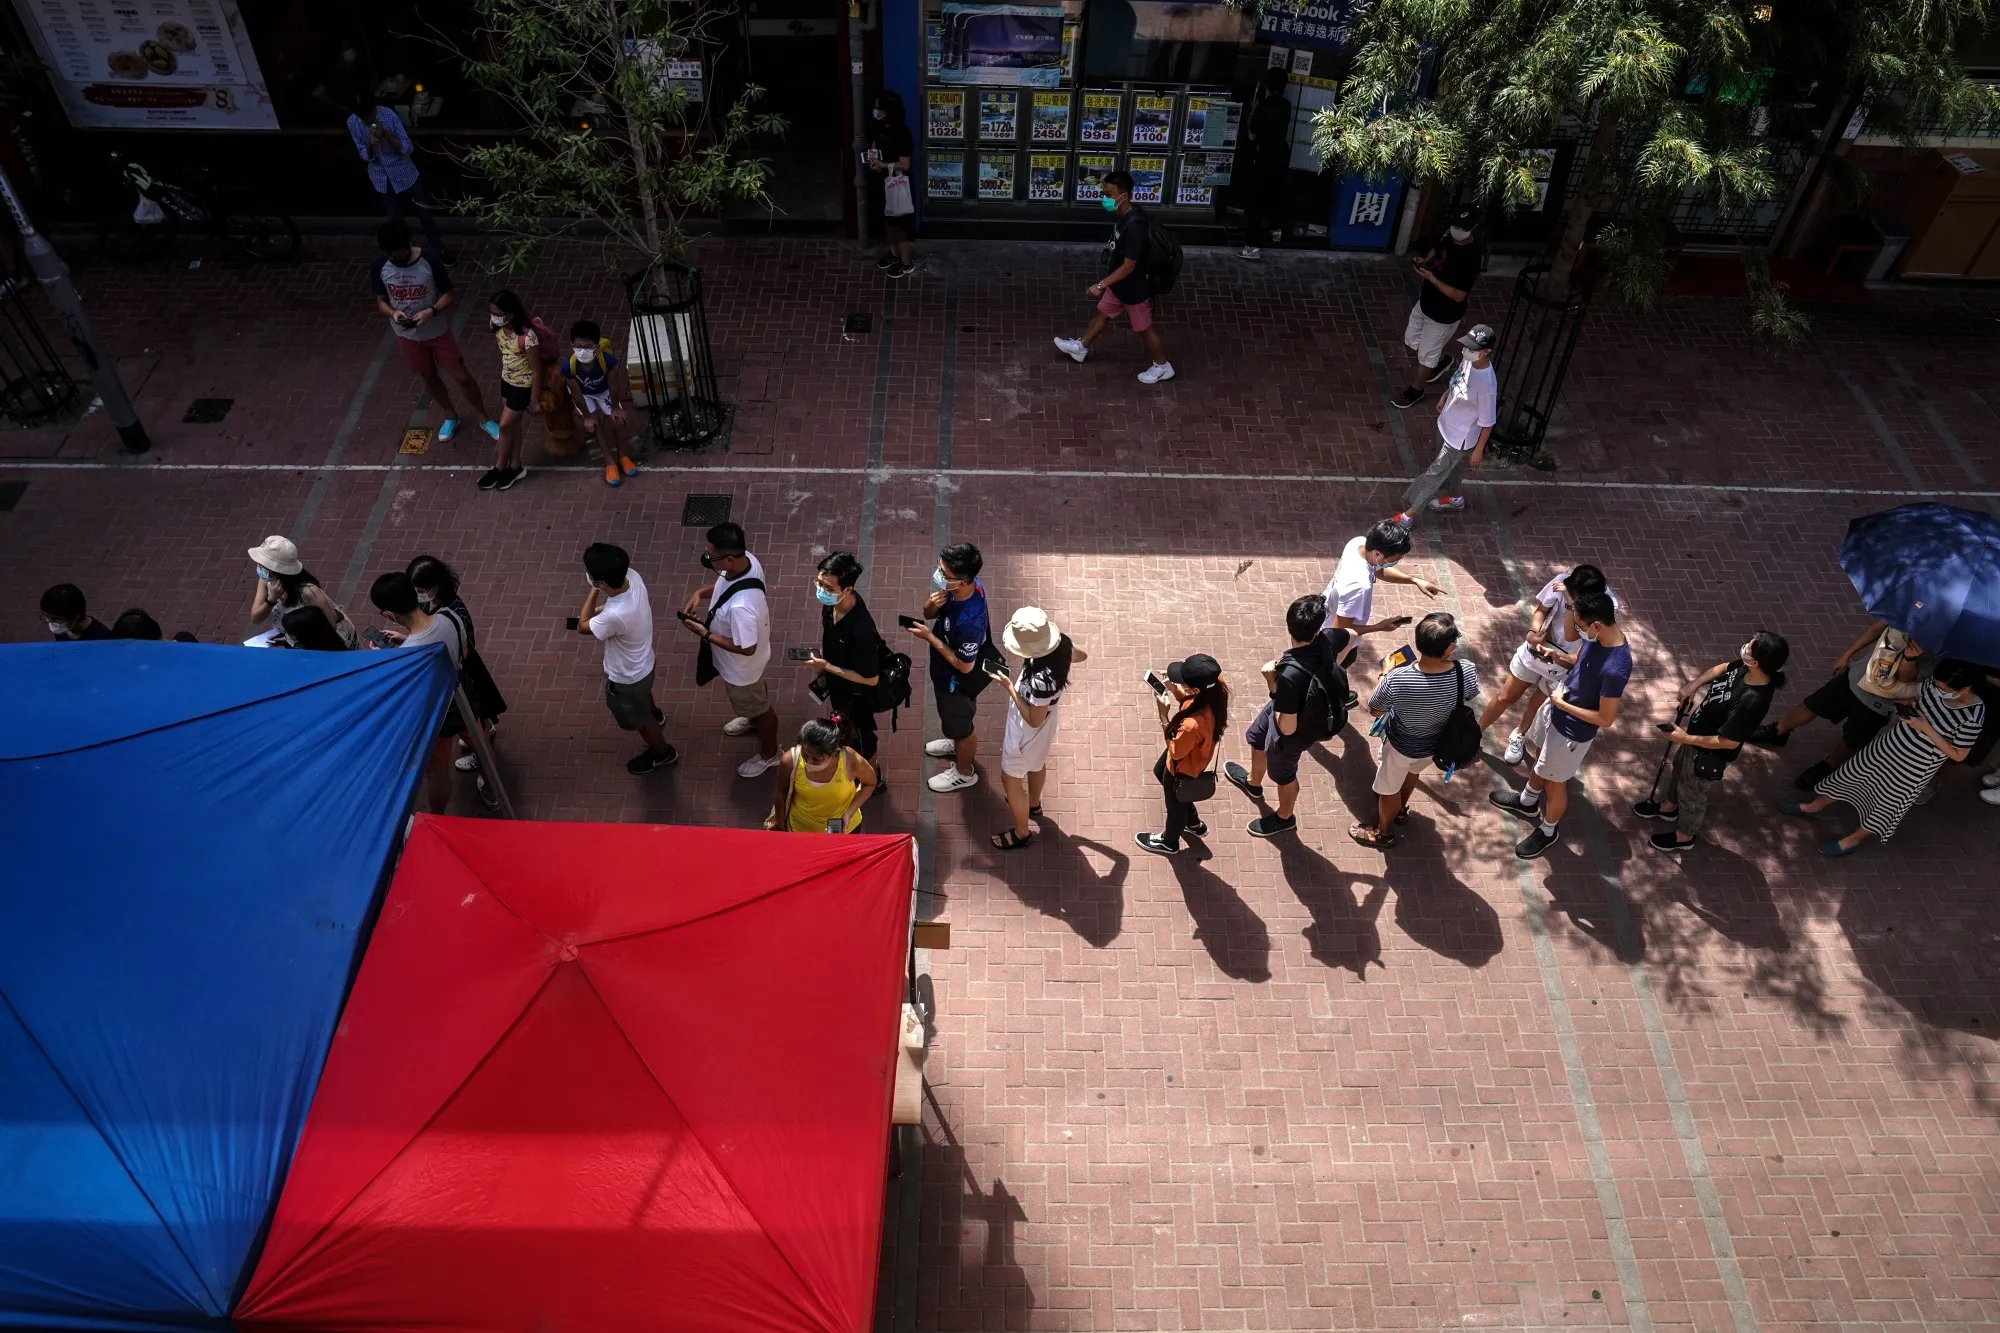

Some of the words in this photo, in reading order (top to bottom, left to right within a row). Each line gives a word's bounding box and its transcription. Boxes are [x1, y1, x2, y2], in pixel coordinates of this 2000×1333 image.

[929, 92, 938, 104] ONE
[939, 92, 963, 104] HOMANTIN
[929, 127, 958, 136] 1028
[1033, 129, 1061, 139] 2450
[1083, 131, 1111, 139] 998
[1134, 133, 1163, 141] 1100
[1186, 134, 1203, 143] 24
[1031, 189, 1058, 198] 1730
[1349, 191, 1390, 227] 閣
